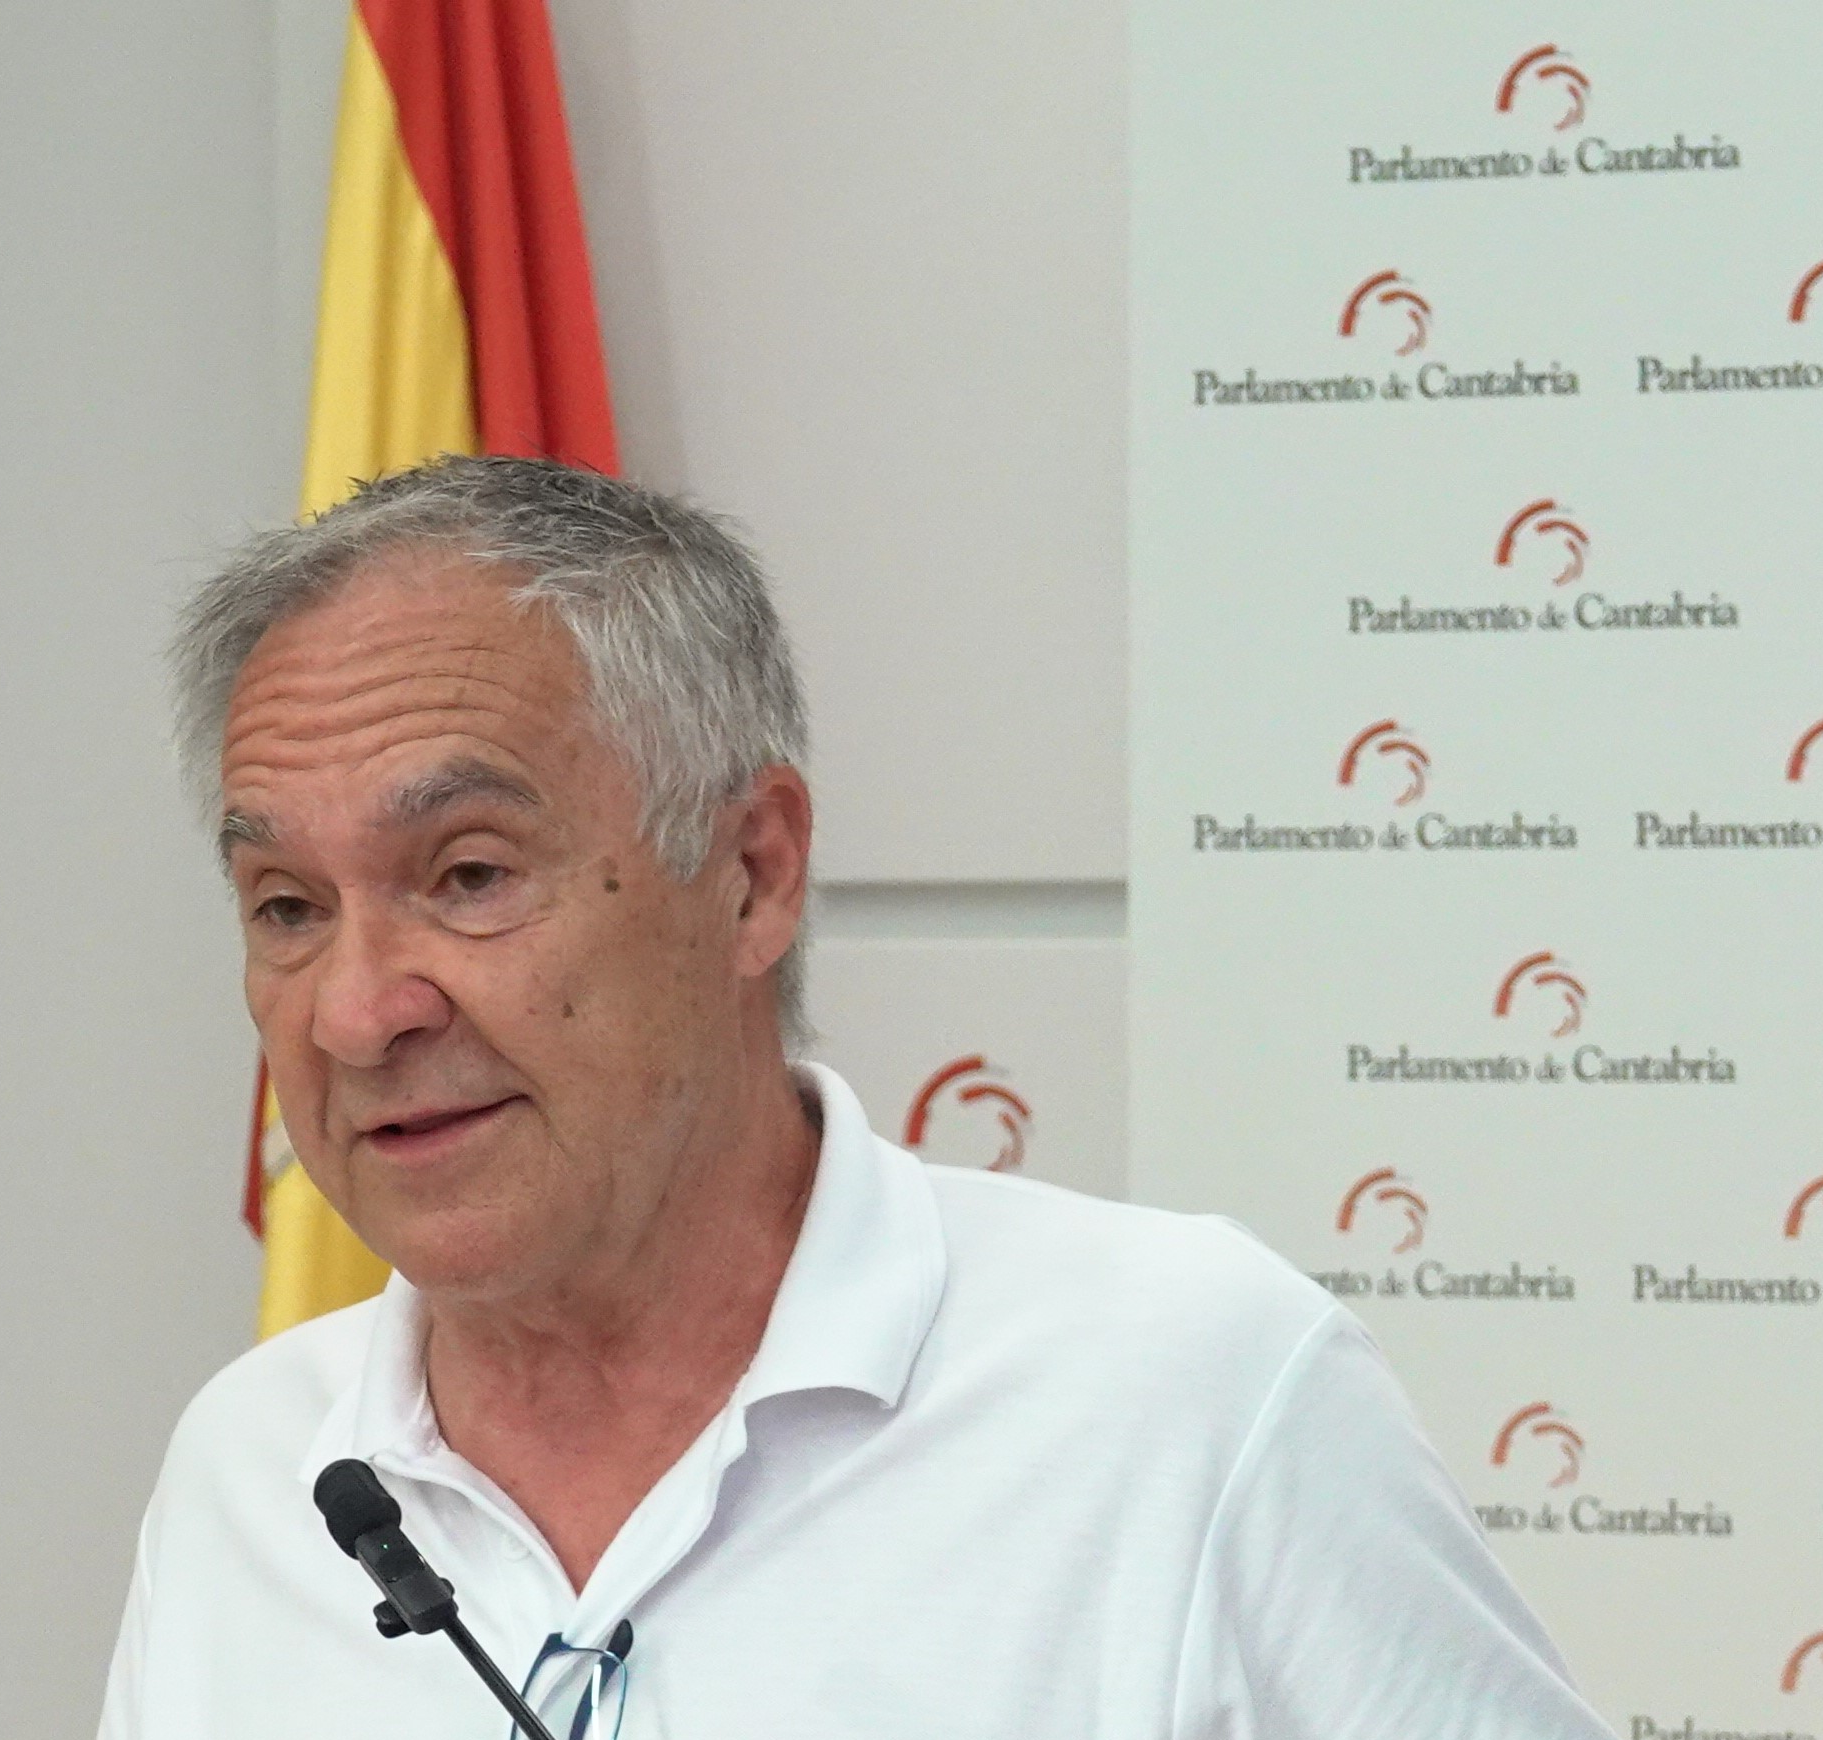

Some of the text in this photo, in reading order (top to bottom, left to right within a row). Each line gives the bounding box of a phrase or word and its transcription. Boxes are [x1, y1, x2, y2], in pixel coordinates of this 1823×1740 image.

[1348, 134, 1740, 184] Parlamento de Cantabria
[1193, 359, 1580, 407] Parlamento de Cantabria
[1348, 591, 1738, 634] Parlamento de Cantabria
[1193, 811, 1578, 852] Parlamento de Cantabria
[1636, 810, 1823, 849] Parlamento
[1347, 1044, 1736, 1085] Parlamento de Cantabria
[1377, 1268, 1407, 1298] de
[1413, 1261, 1575, 1301] Cantabria
[1633, 1264, 1822, 1304] Parlamento
[1532, 1503, 1563, 1533] de
[1569, 1496, 1734, 1538] Cantabria
